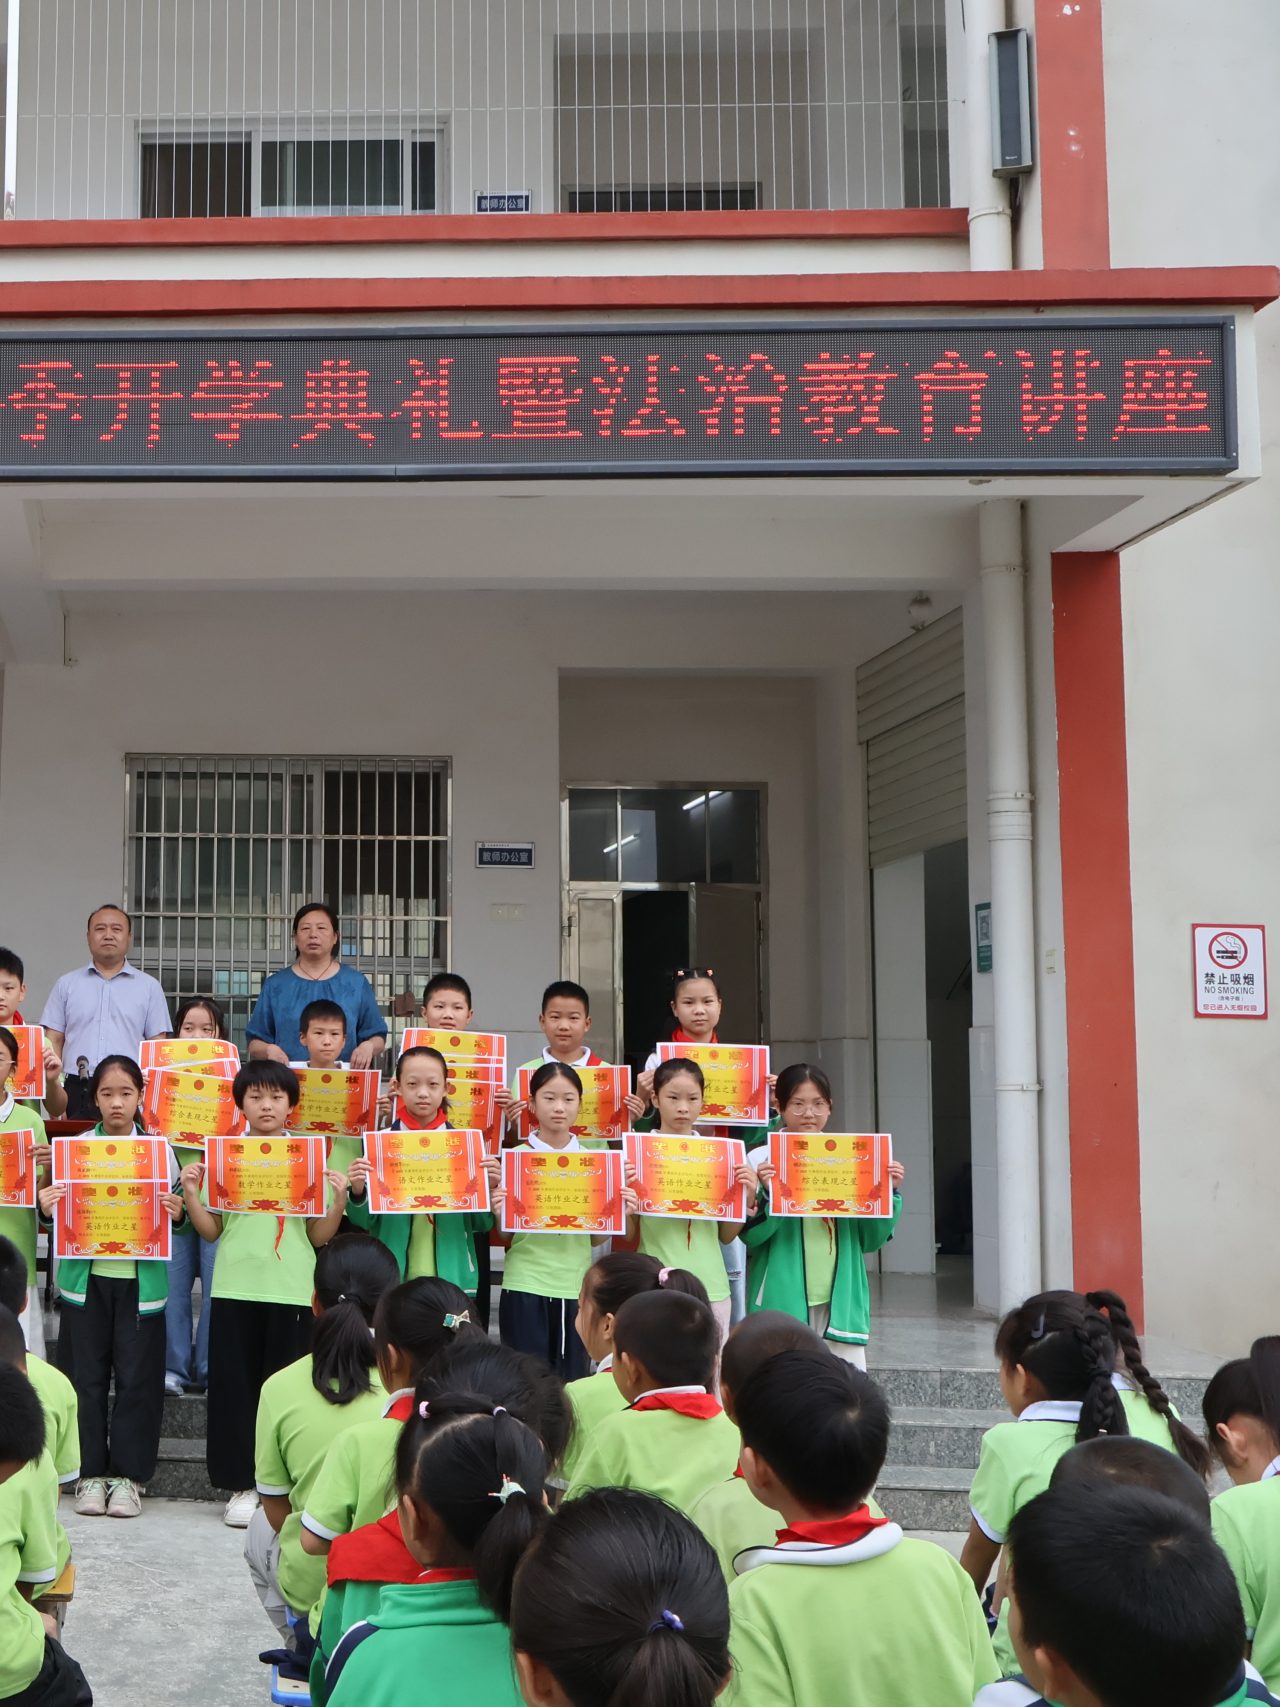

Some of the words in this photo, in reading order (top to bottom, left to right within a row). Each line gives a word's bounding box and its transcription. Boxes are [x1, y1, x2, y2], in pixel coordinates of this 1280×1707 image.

[482, 851, 529, 862] 教师办公室
[1204, 973, 1254, 985] 禁止吸烟
